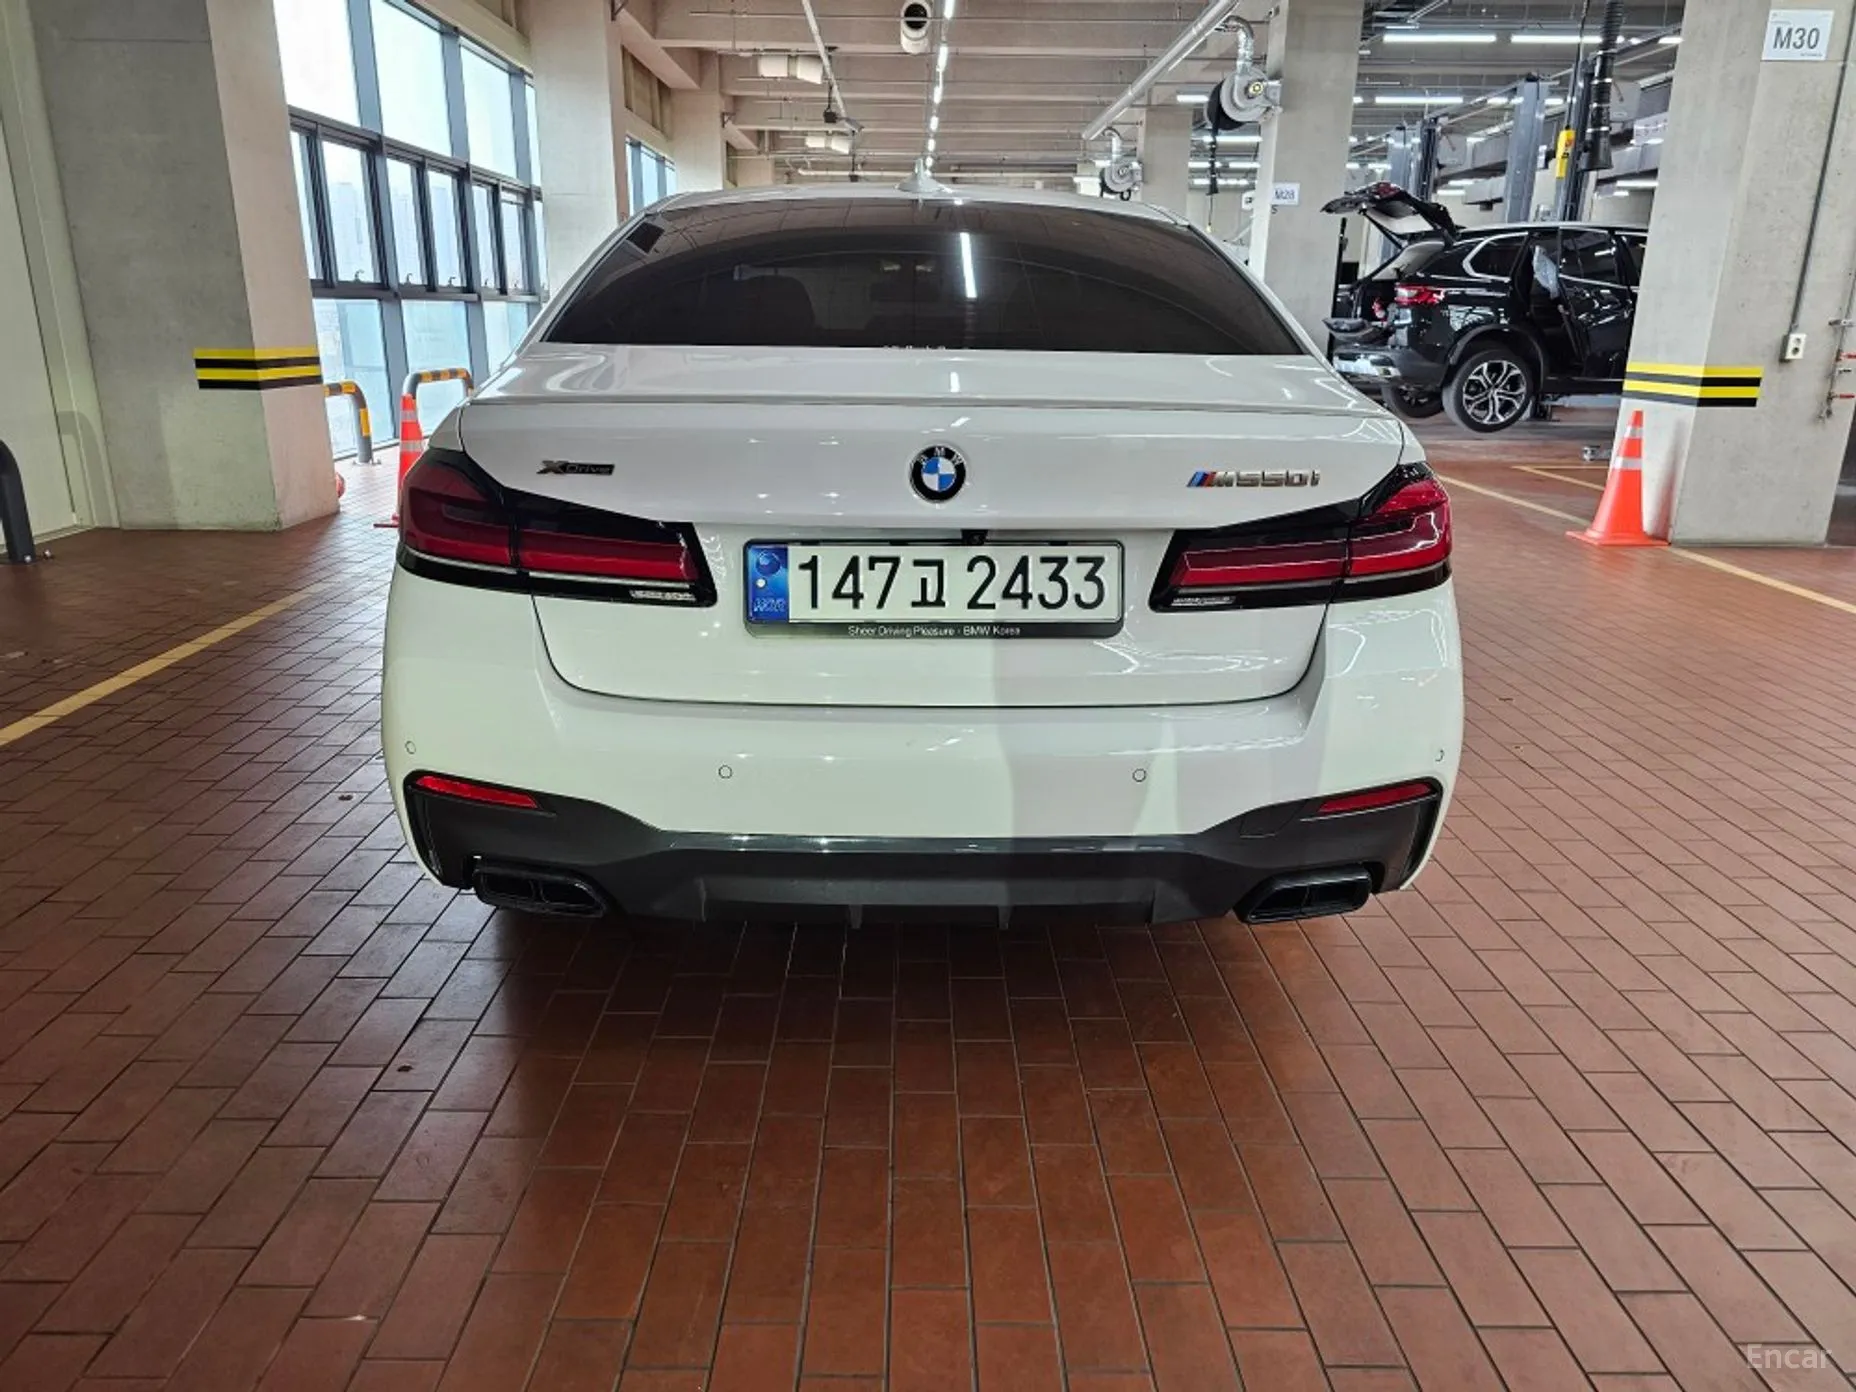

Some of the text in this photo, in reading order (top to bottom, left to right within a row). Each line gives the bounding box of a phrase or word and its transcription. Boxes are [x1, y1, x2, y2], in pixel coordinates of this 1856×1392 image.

[1772, 27, 1821, 50] M30
[1211, 470, 1321, 488] M550i
[798, 554, 1106, 610] 147고 2433
[848, 625, 1021, 638] Sheer Driving Pleasure BMW Korea
